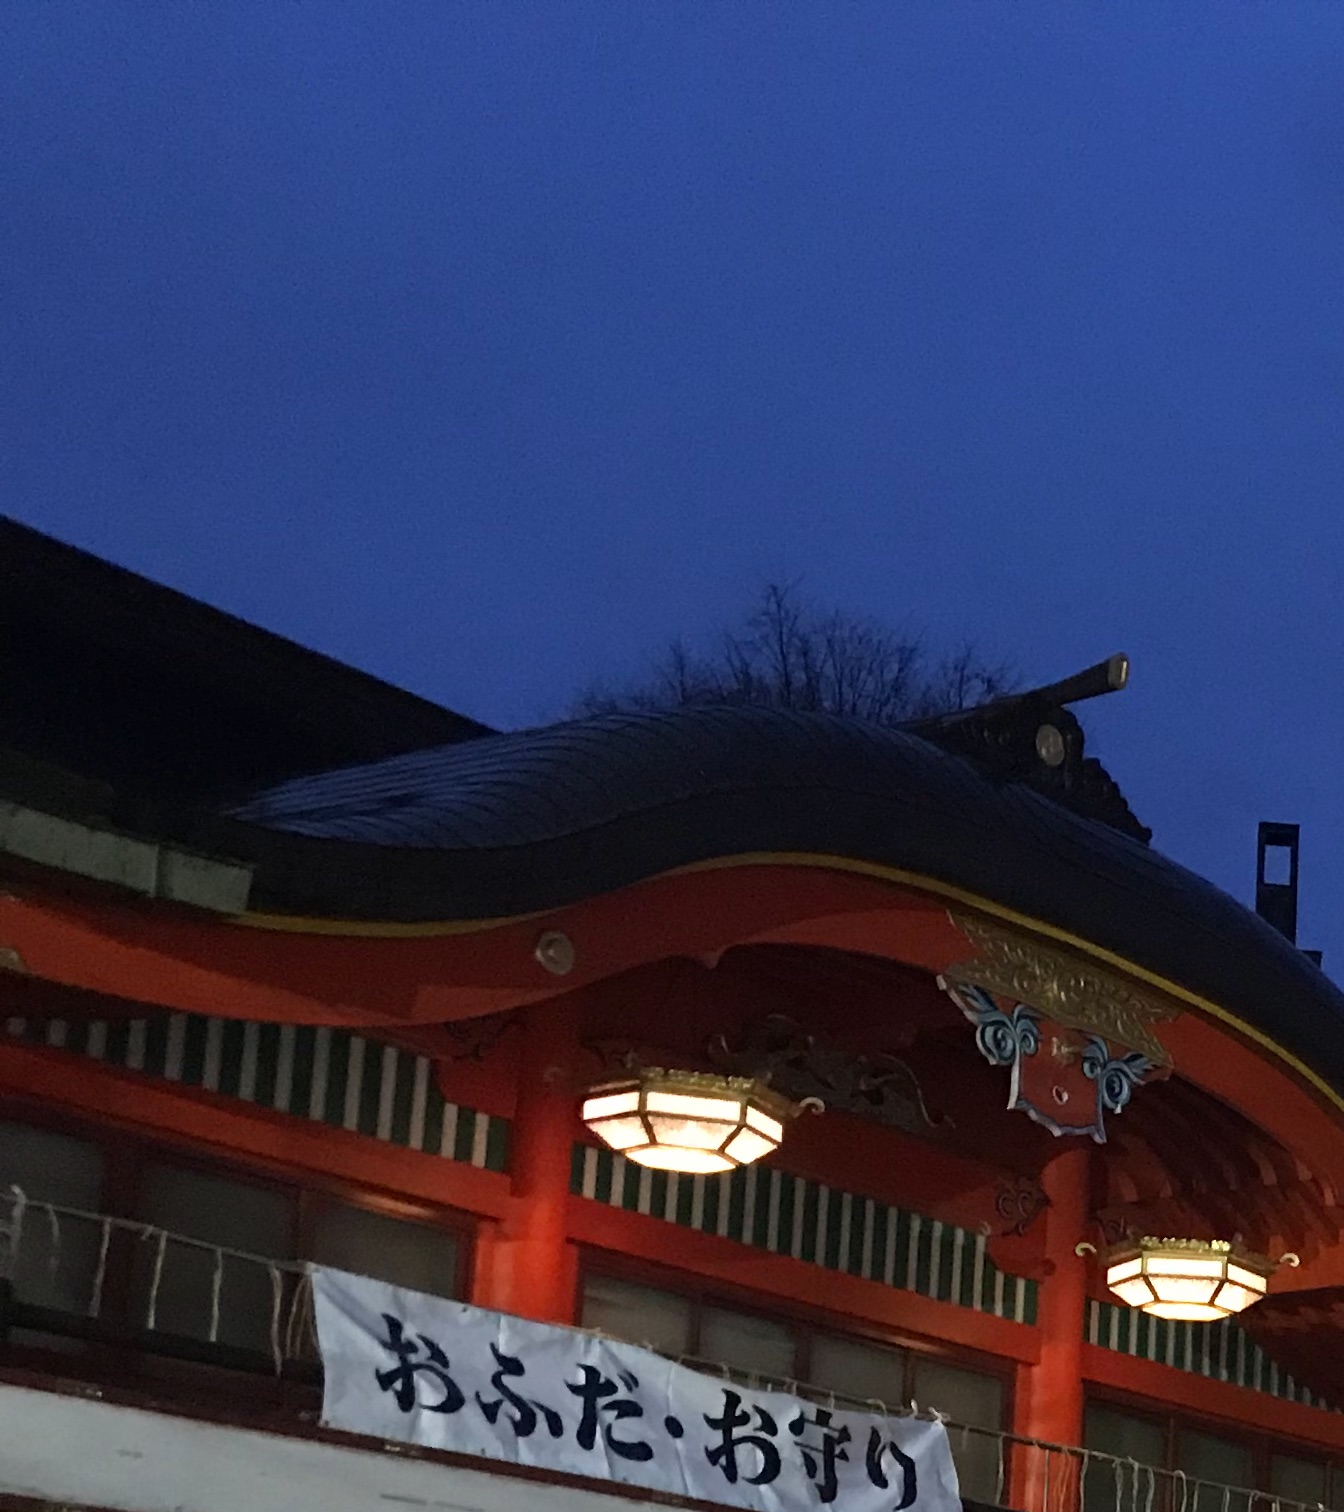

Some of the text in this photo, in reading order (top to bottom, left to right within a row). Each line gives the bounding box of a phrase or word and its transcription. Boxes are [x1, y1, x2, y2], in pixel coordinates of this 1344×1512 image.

[375, 1312, 918, 1511] おふだ・お守り
